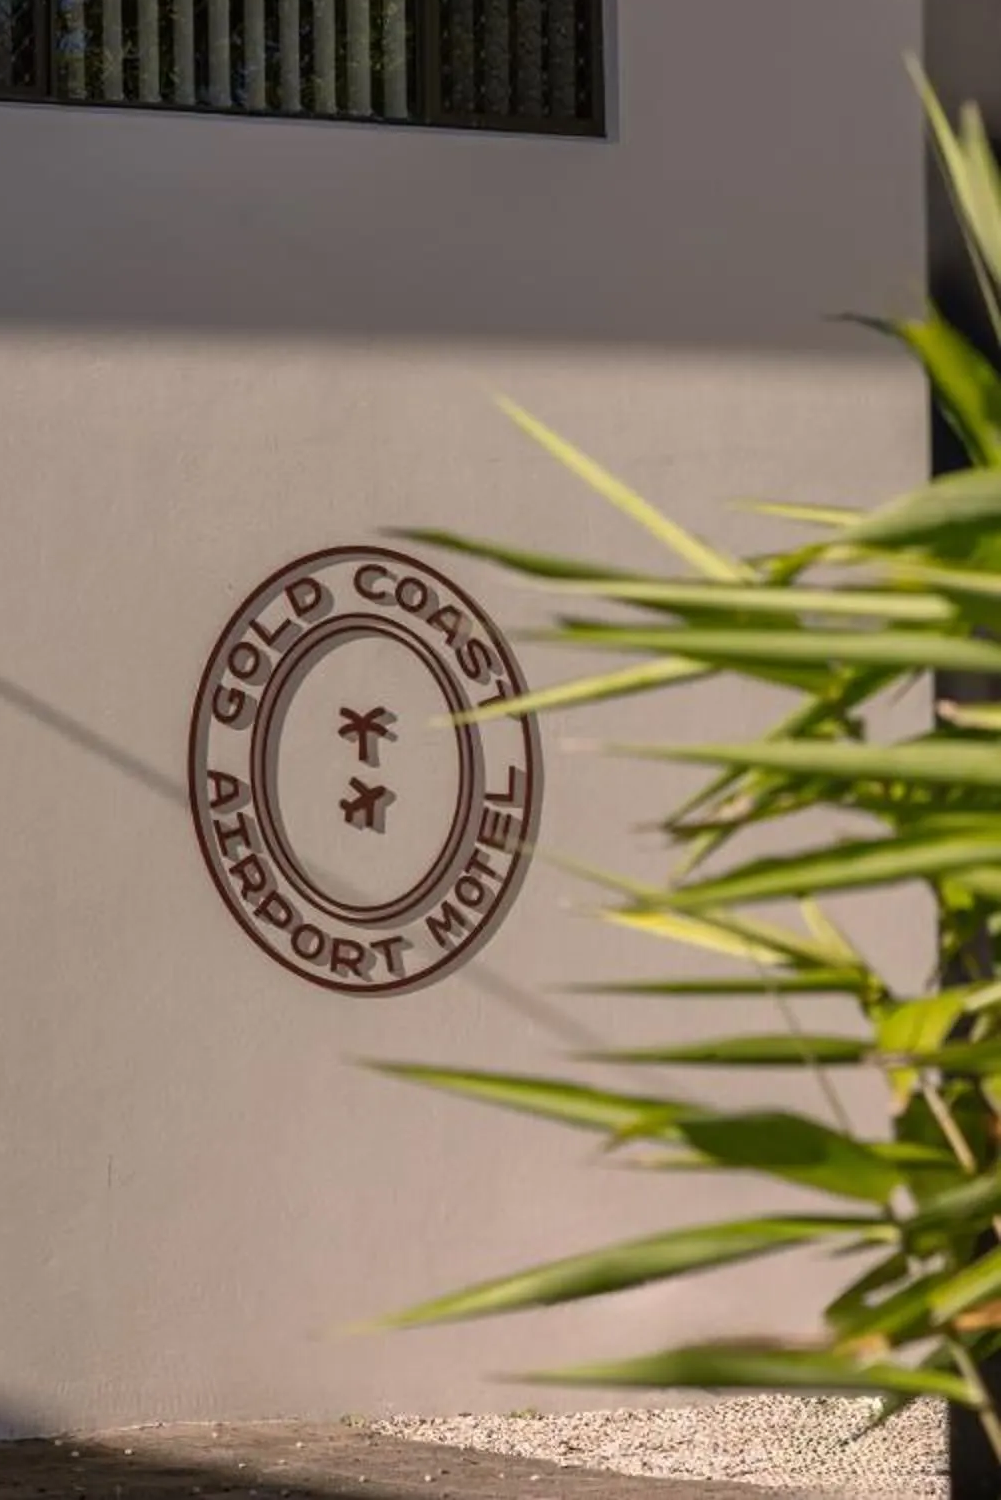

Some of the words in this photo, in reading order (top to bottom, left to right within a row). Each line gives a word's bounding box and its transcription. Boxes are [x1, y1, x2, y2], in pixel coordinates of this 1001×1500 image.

[212, 577, 322, 725] GOLD
[353, 564, 512, 713] COAST
[206, 769, 407, 977] AIRPORT
[425, 765, 517, 947] MOTEL
